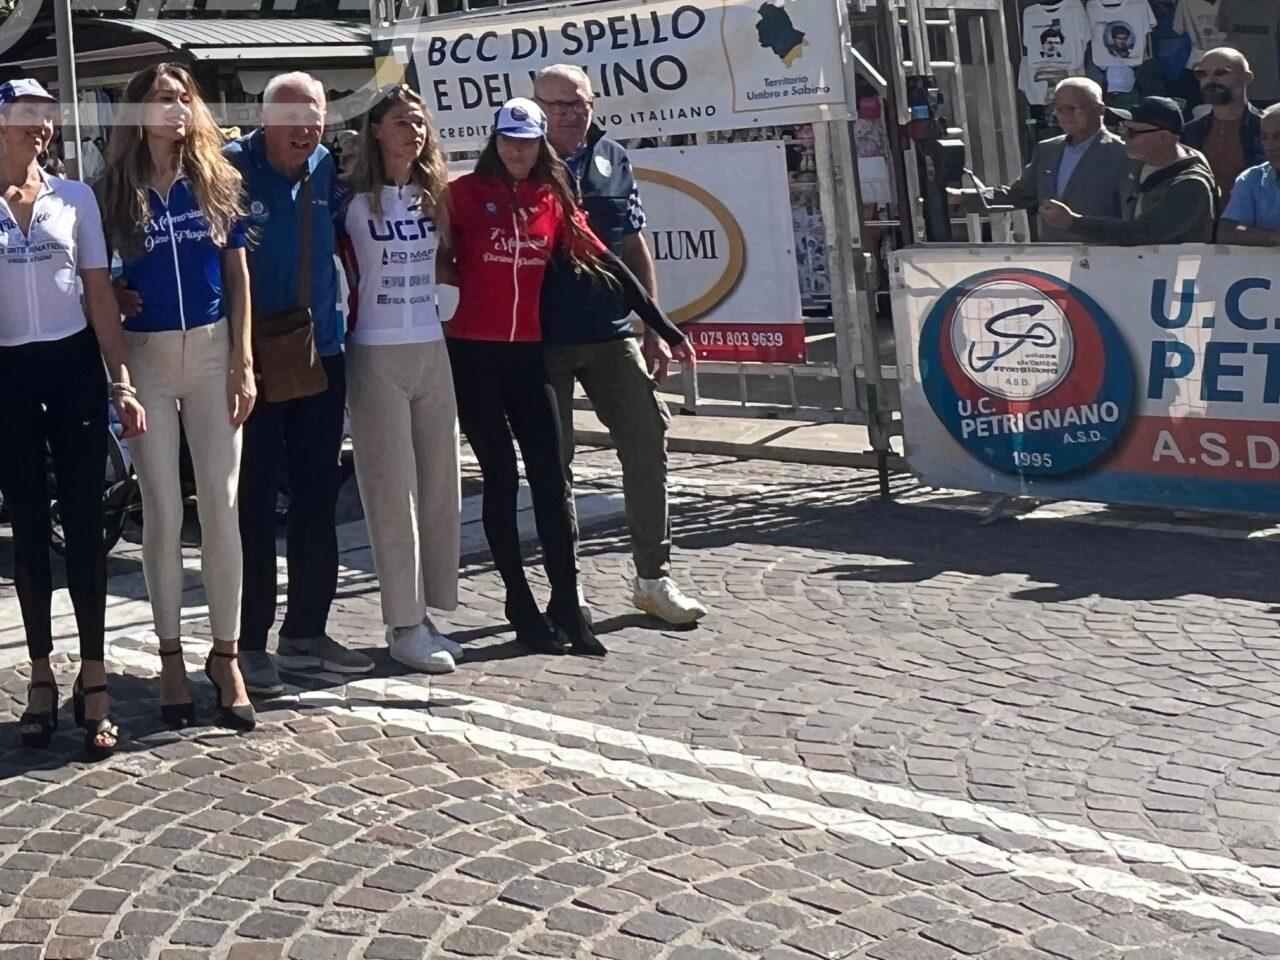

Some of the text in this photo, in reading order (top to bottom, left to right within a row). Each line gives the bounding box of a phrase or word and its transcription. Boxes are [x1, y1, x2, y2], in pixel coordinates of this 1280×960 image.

[428, 5, 706, 66] BCC DI SPELLO
[433, 79, 452, 111] E
[630, 105, 717, 124] ITALIANO
[367, 217, 437, 241] UCP
[652, 229, 719, 261] LUMI
[957, 397, 996, 416] U.C.
[961, 401, 1119, 439] PETRIGNANO
[1013, 451, 1052, 468] 1995
